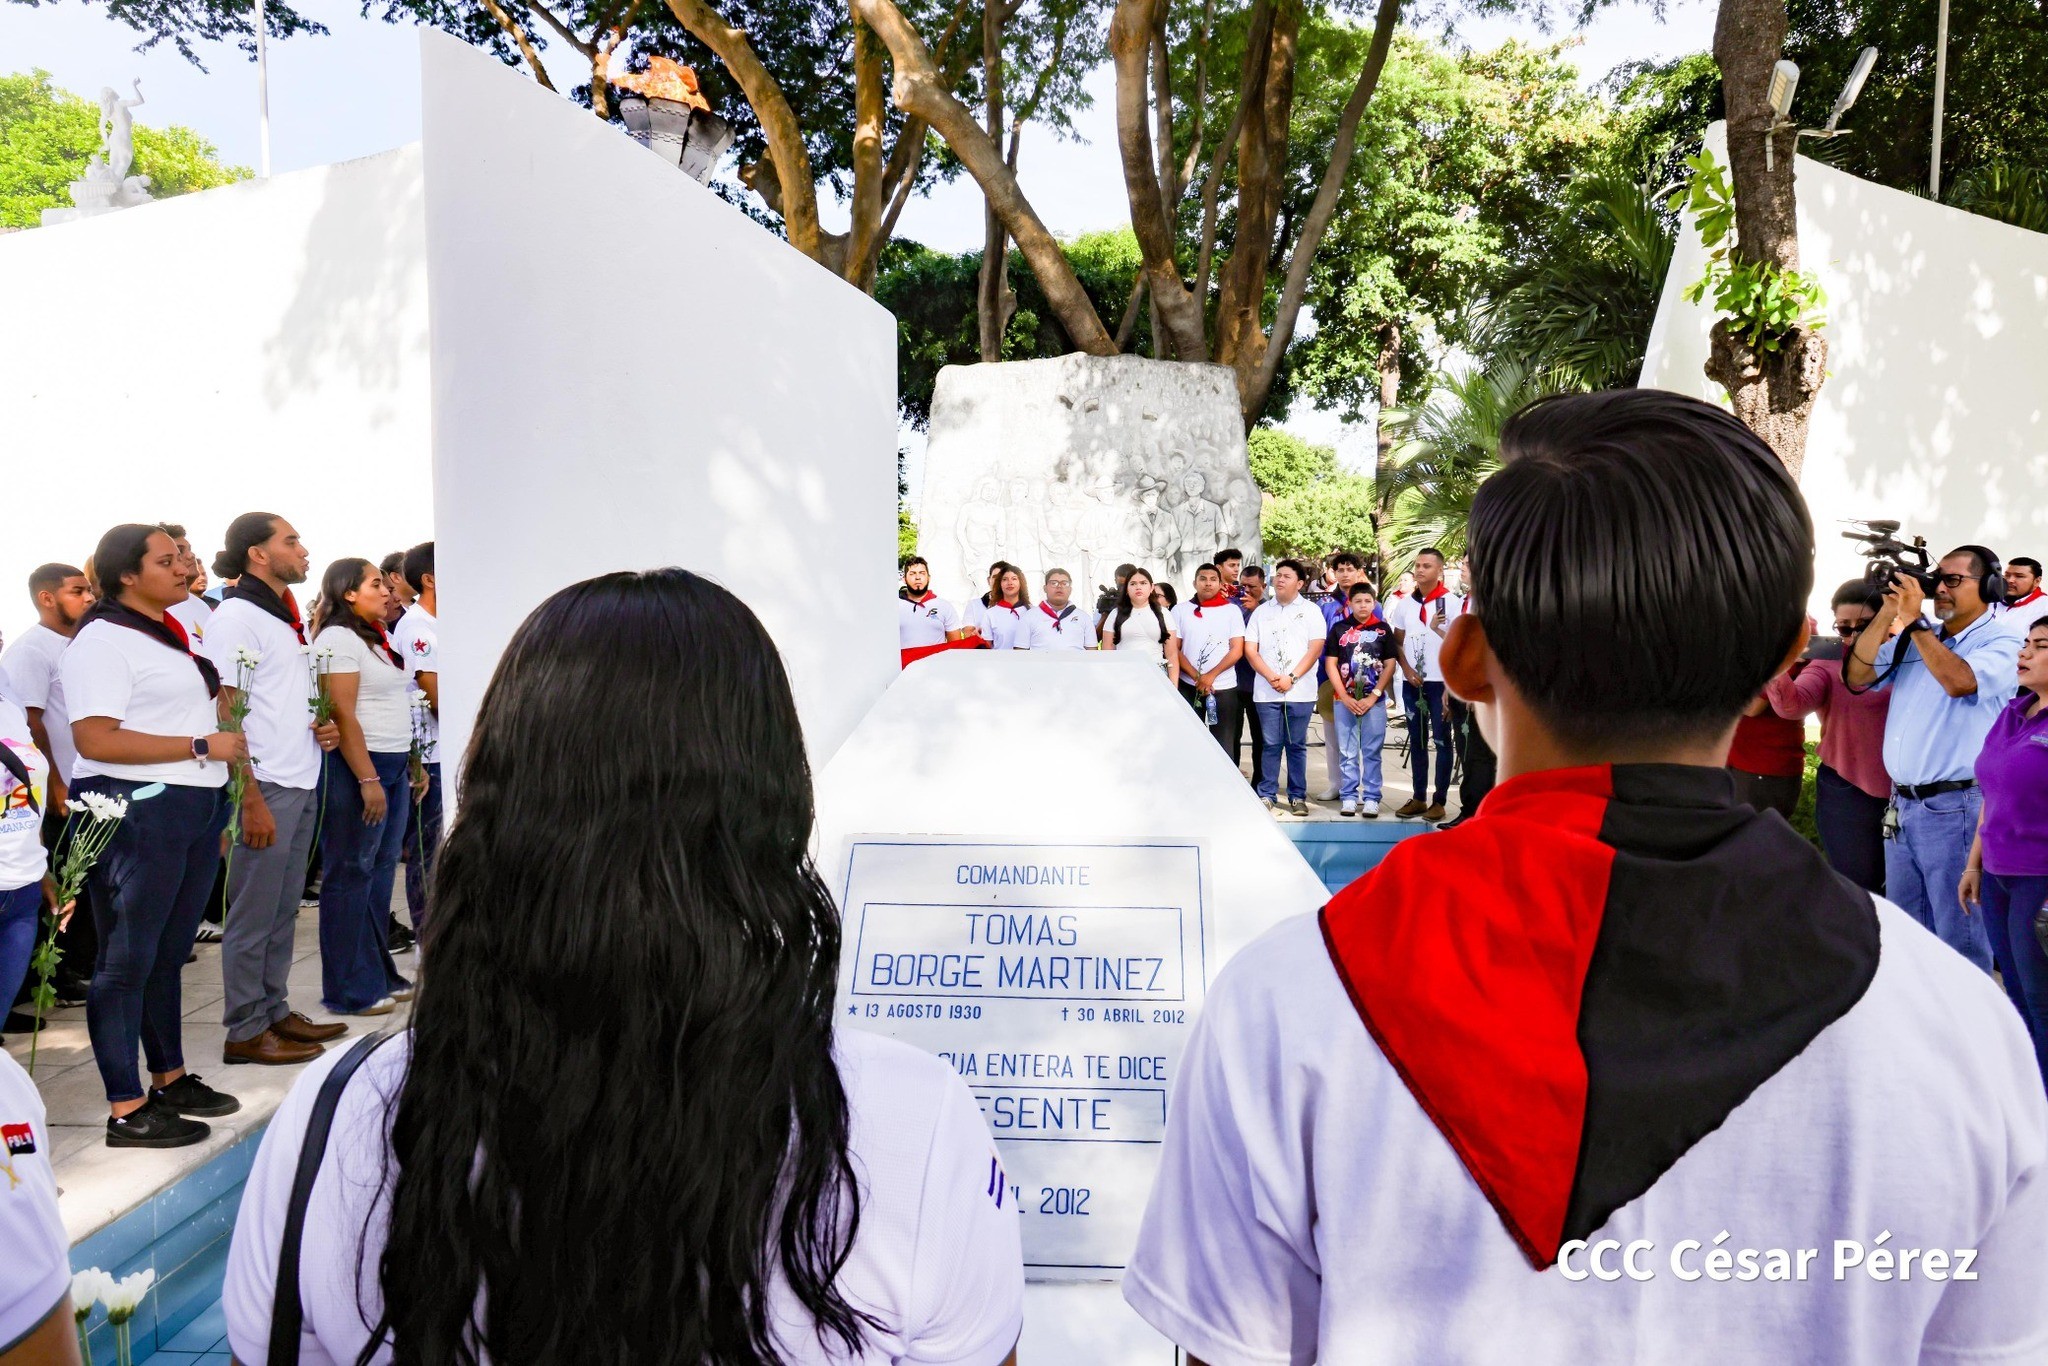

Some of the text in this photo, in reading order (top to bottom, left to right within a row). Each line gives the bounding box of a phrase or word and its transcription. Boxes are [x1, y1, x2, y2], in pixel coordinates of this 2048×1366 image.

[956, 864, 1090, 886] COMANDANTE
[965, 913, 1078, 947] TOMAS
[870, 953, 1166, 992] BORGE MARTINEZ
[865, 1002, 982, 1020] 13 AGOSTO 1930
[1077, 1007, 1185, 1025] 30 ABRIL 2012
[985, 1053, 1074, 1079] ENTERA
[1083, 1054, 1111, 1080] TE
[1118, 1055, 1167, 1081] DICE
[1039, 1186, 1091, 1216] 2012
